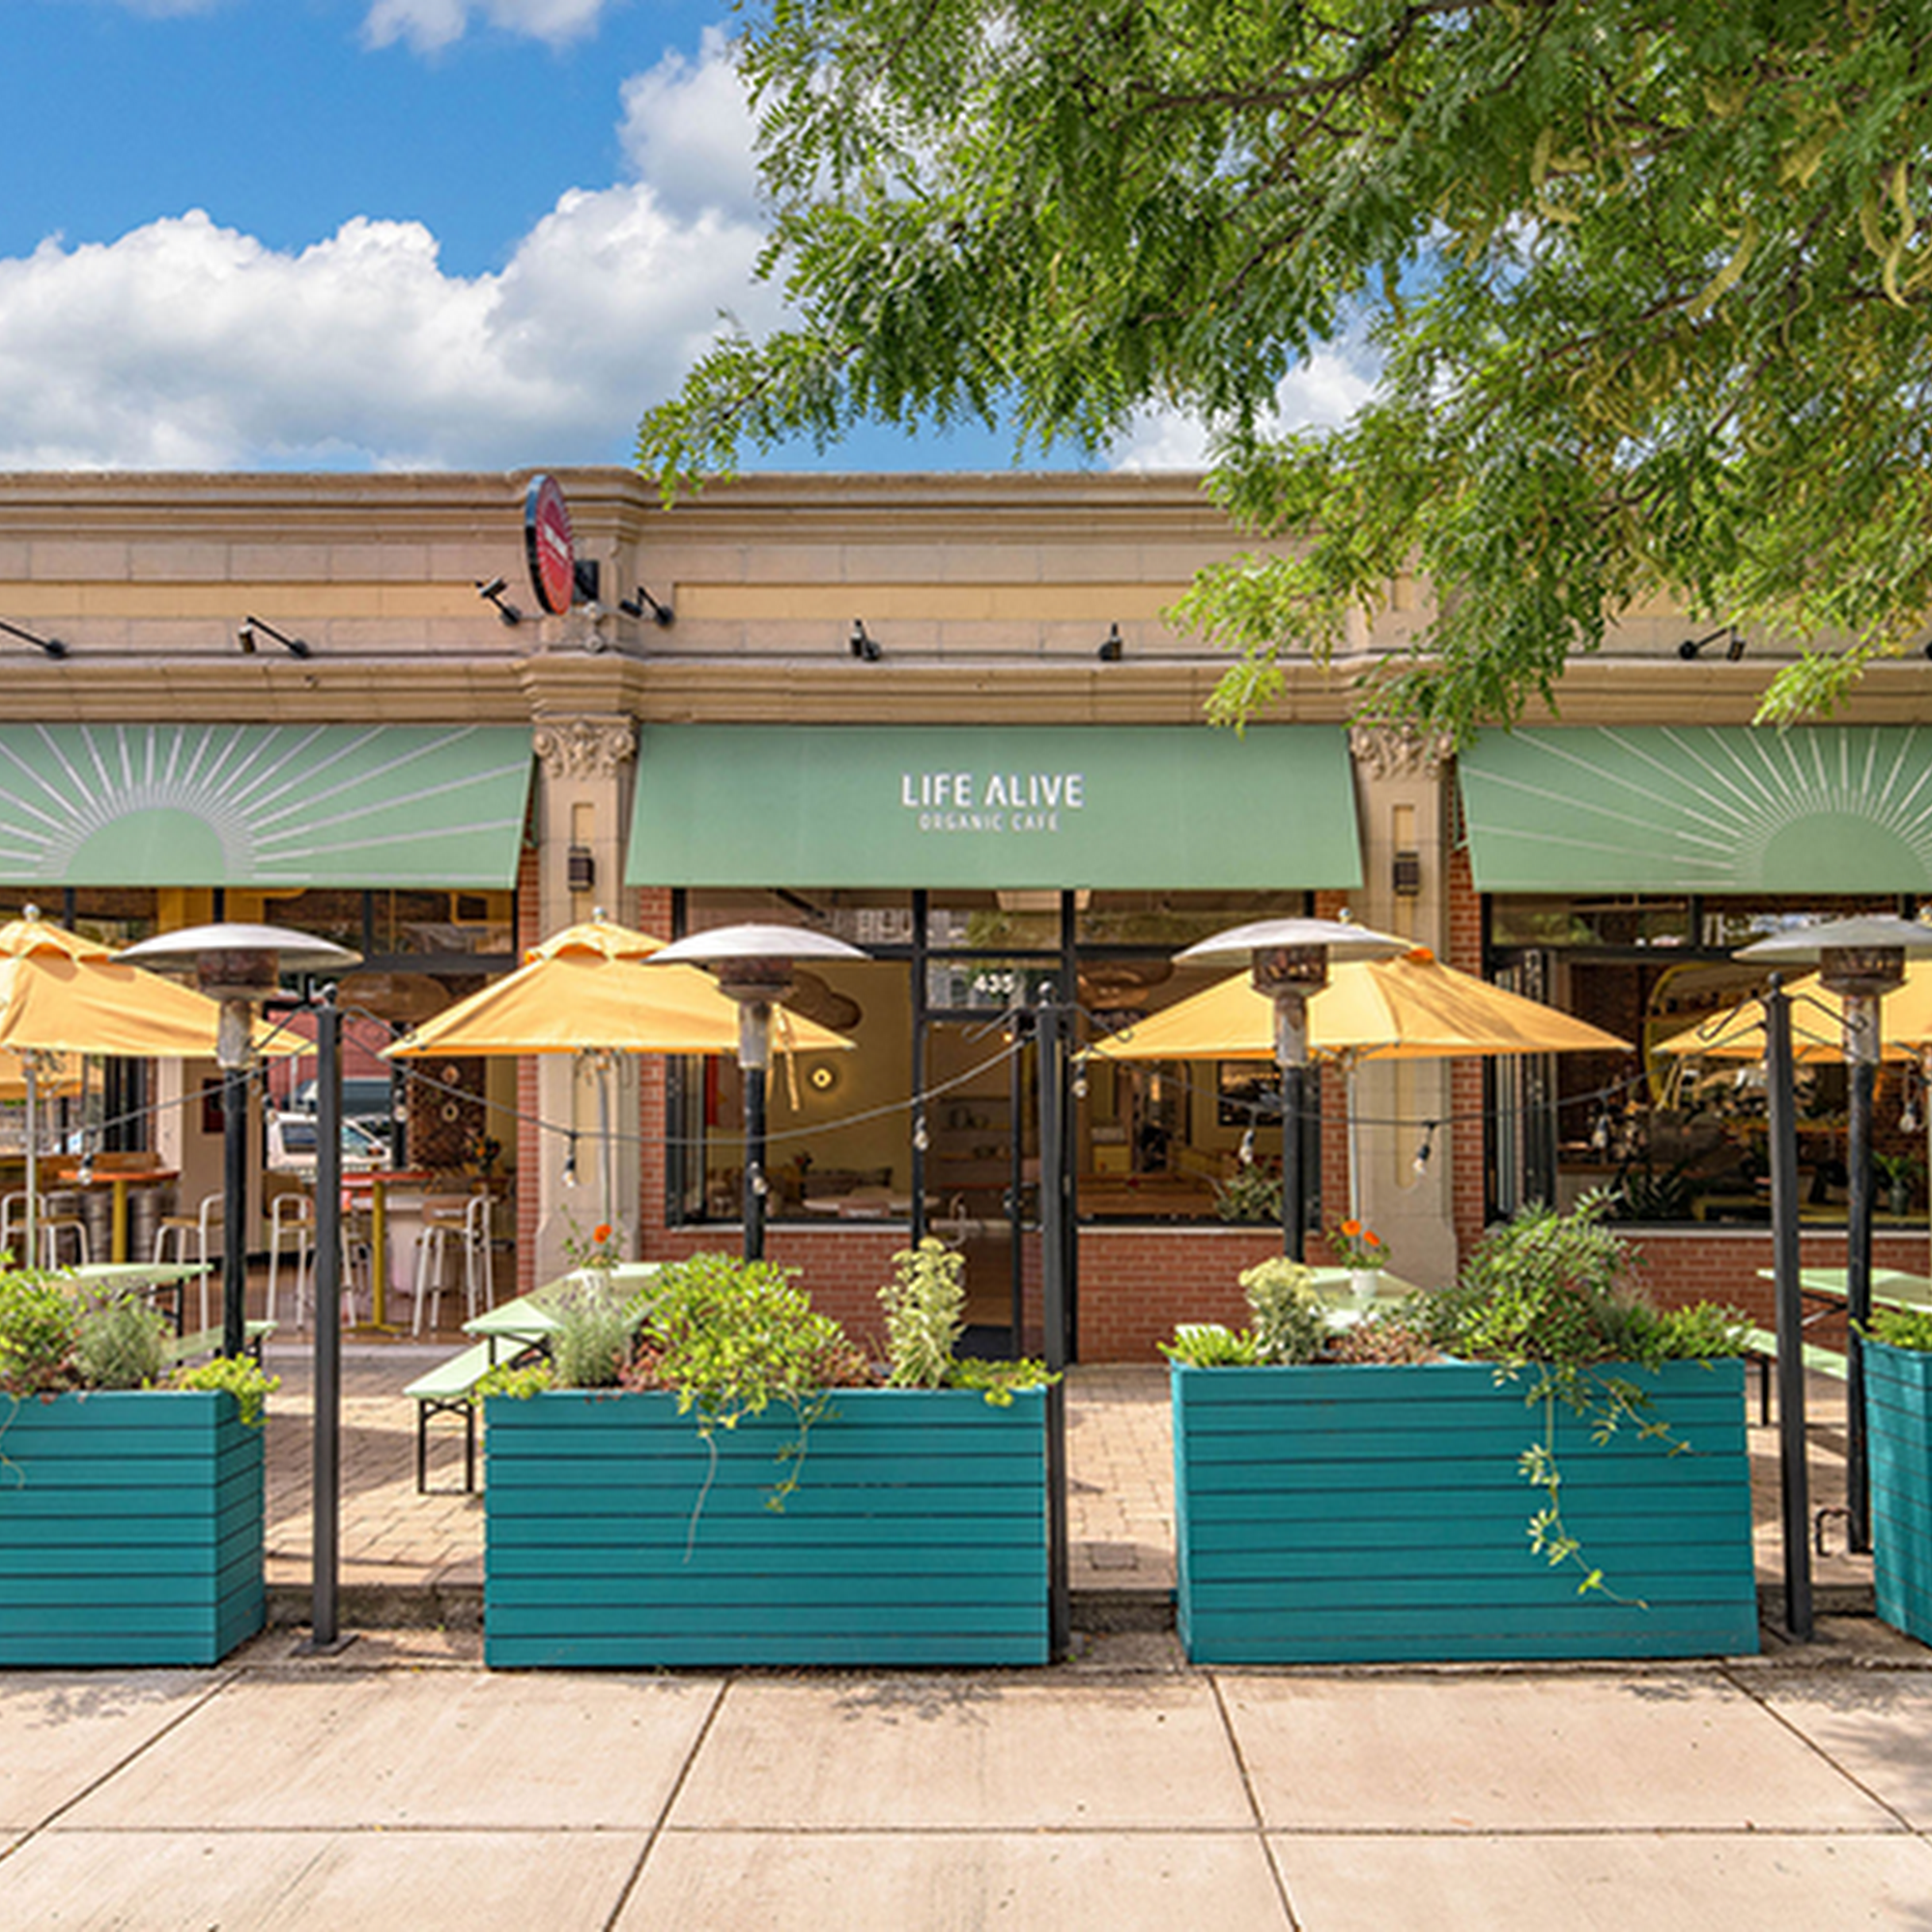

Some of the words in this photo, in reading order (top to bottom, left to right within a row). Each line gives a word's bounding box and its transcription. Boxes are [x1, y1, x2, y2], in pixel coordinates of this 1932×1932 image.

[902, 775, 972, 807] LIFE
[984, 775, 1084, 807] ALIVE
[919, 813, 1002, 832] ORGANIC
